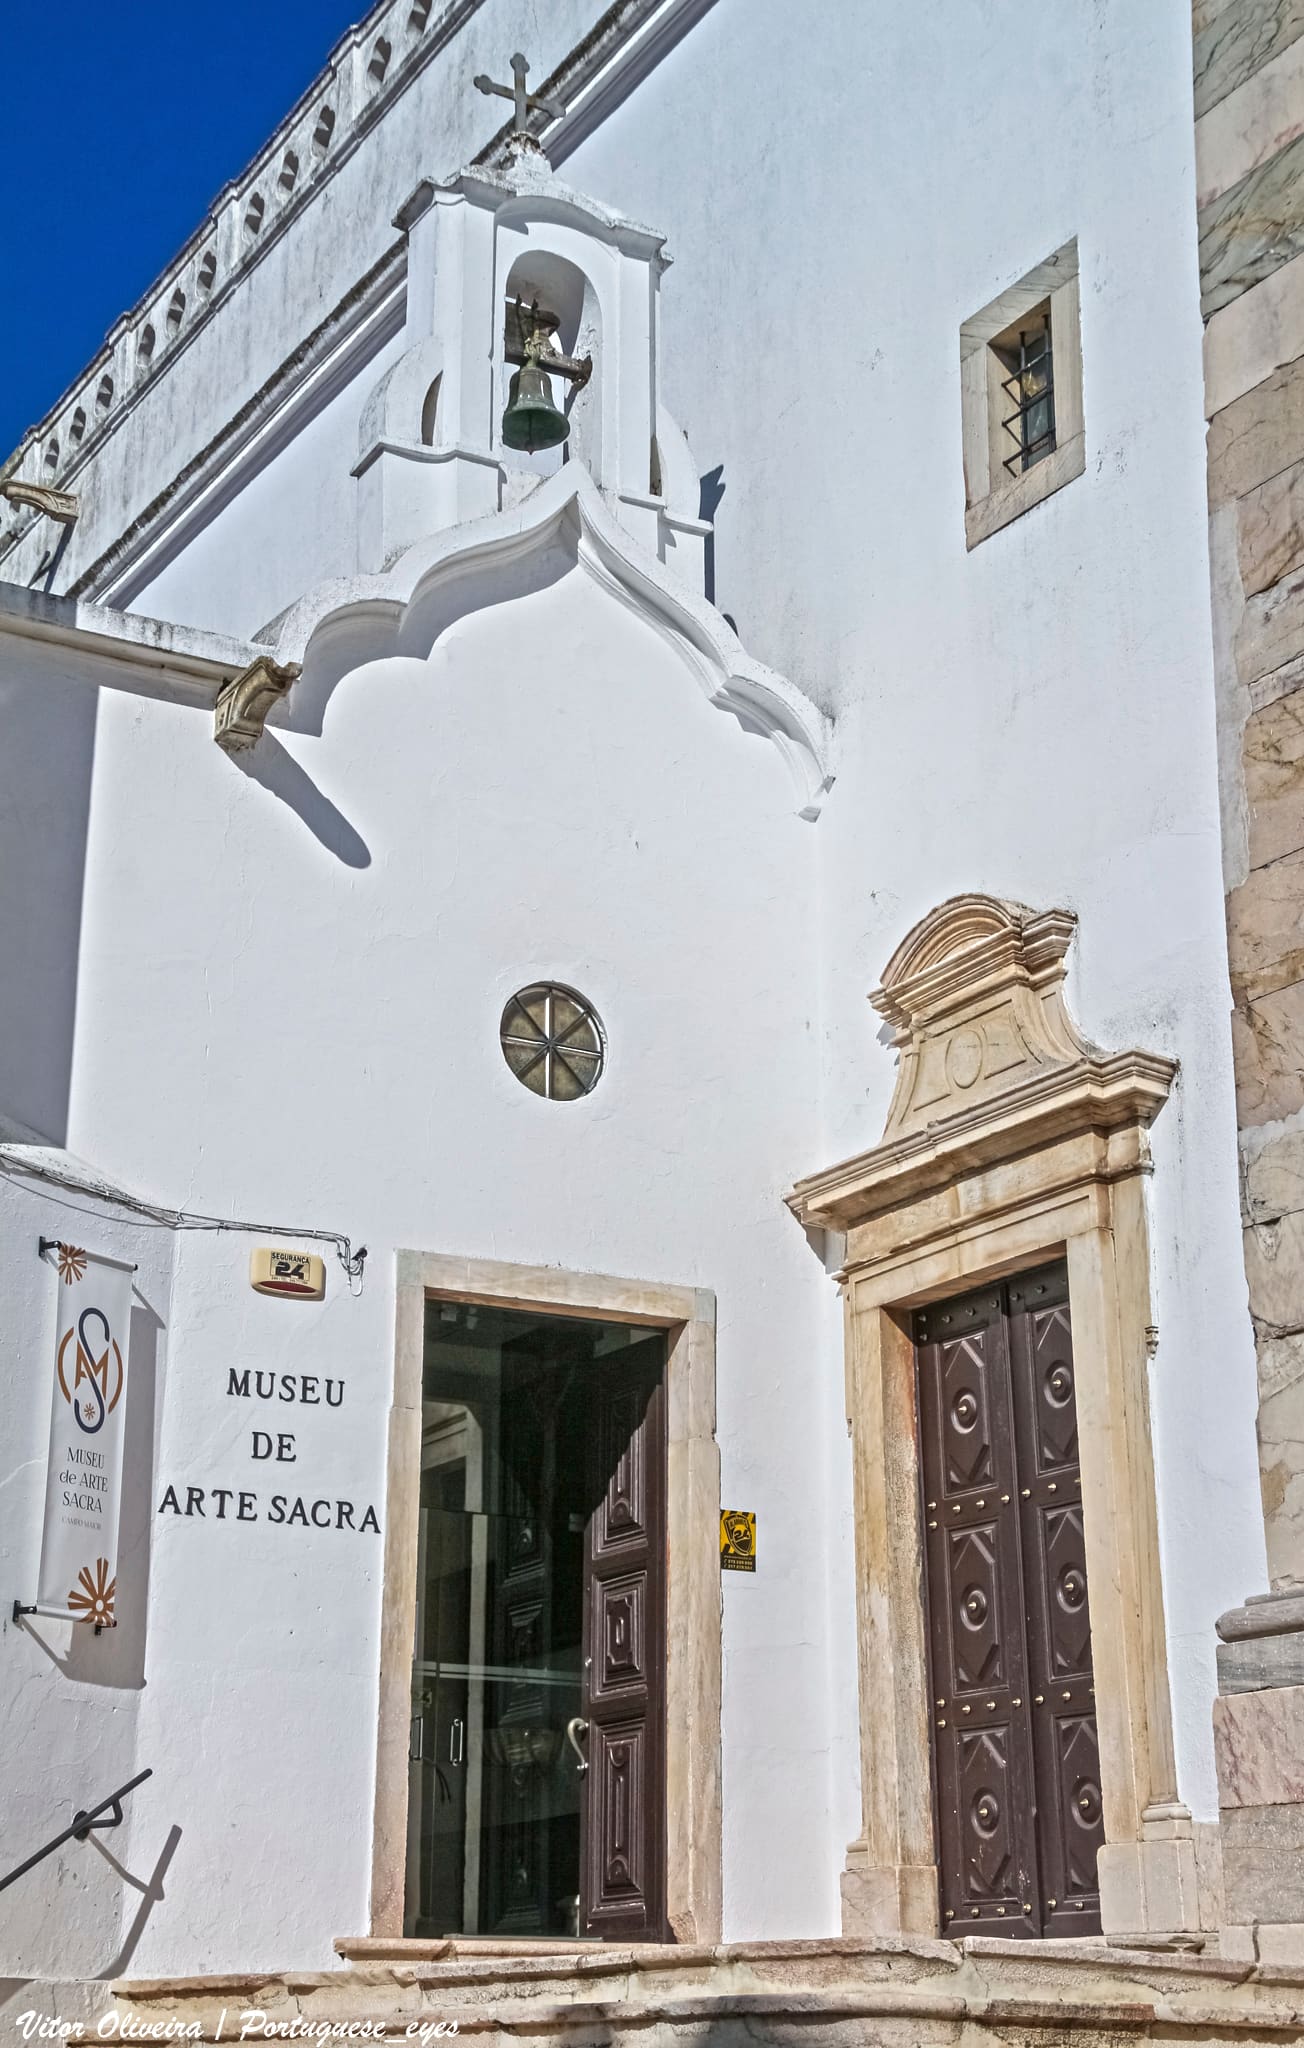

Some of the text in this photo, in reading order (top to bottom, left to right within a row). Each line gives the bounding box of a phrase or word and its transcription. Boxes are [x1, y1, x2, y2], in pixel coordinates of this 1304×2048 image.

[275, 1261, 304, 1280] 24
[226, 1367, 345, 1407] MUSEU
[67, 1446, 105, 1469] MUSEU
[251, 1431, 297, 1462] DE
[60, 1469, 108, 1492] de ARTE
[62, 1490, 102, 1513] SACRA
[158, 1484, 381, 1534] ARTE SACRA
